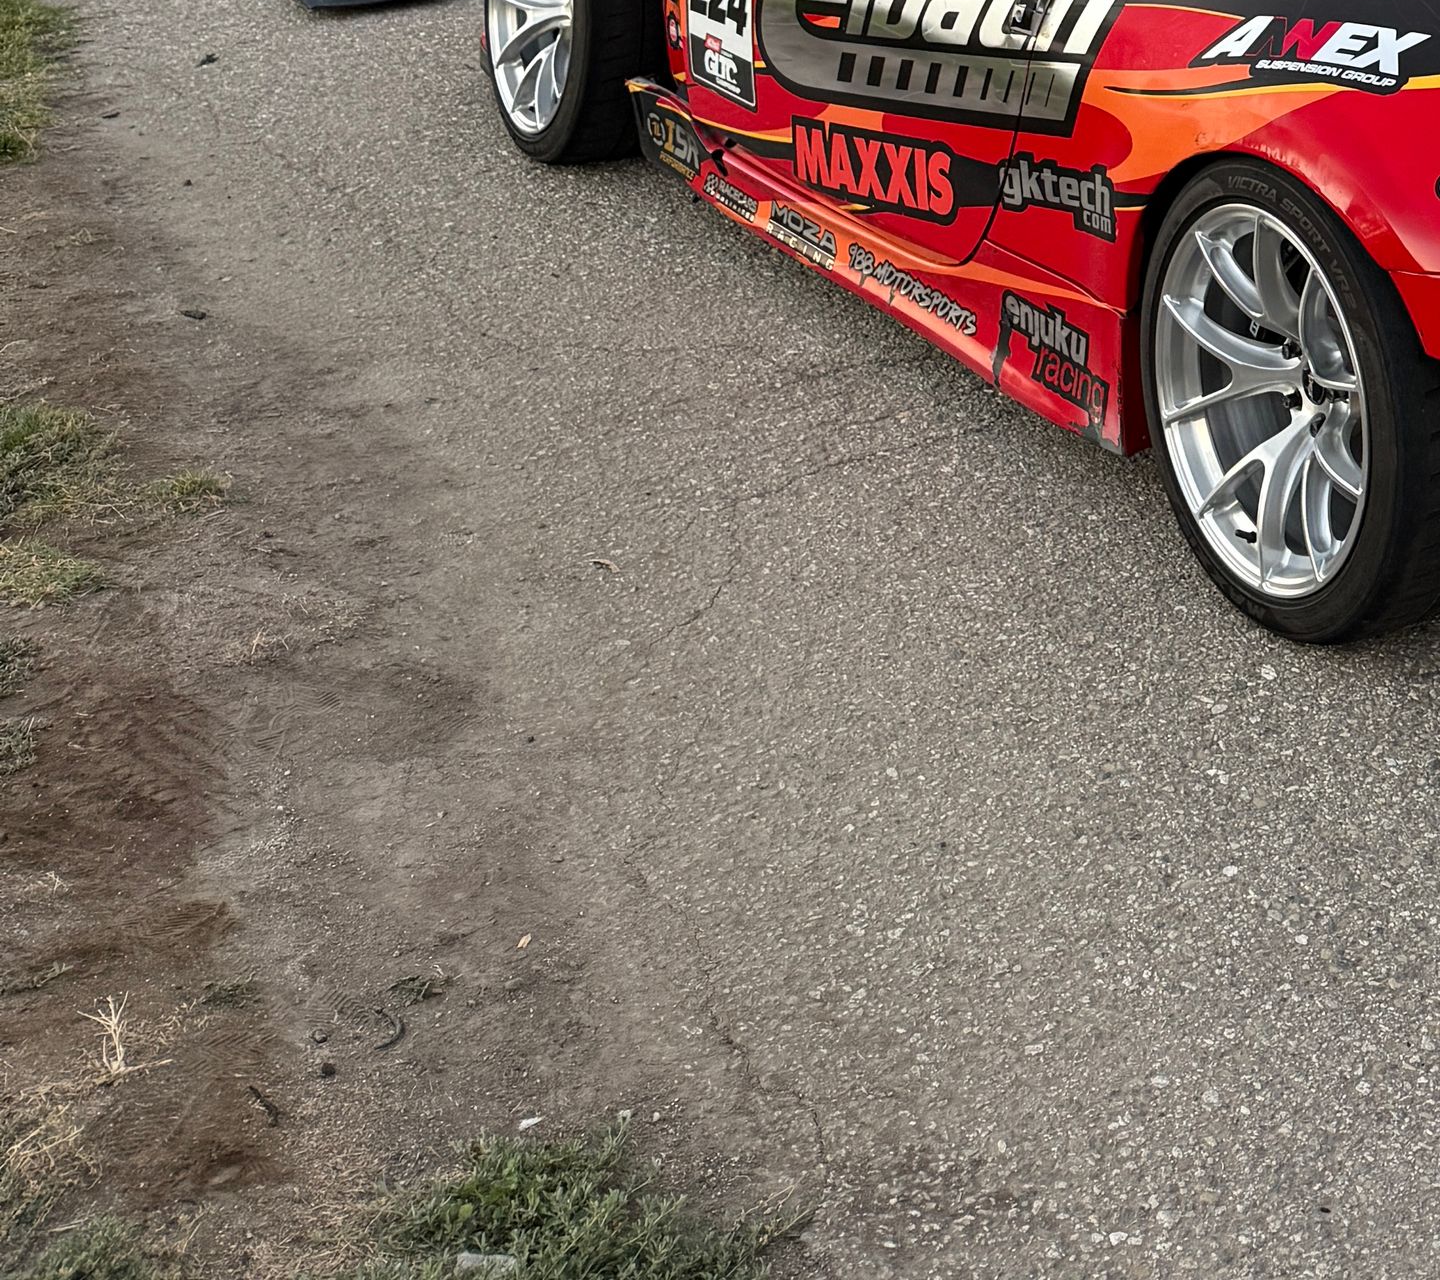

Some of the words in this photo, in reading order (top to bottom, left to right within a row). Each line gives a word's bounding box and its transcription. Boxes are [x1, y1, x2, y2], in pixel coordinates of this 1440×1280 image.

[704, 49, 738, 85] GLTC
[1202, 15, 1432, 76] ANNEX
[1256, 58, 1342, 78] SUSPENSION
[1341, 69, 1397, 87] GROUP
[795, 123, 954, 217] MAXXIS
[999, 160, 1111, 217] gktech
[771, 200, 837, 253] MOZA
[1228, 175, 1277, 203] VICTRA
[1279, 198, 1331, 253] SPORT
[766, 224, 835, 270] RACING
[849, 243, 875, 276] 988
[874, 260, 977, 335] MOTORSPORTS
[1005, 295, 1087, 366] enjuku
[1036, 346, 1105, 424] racing
